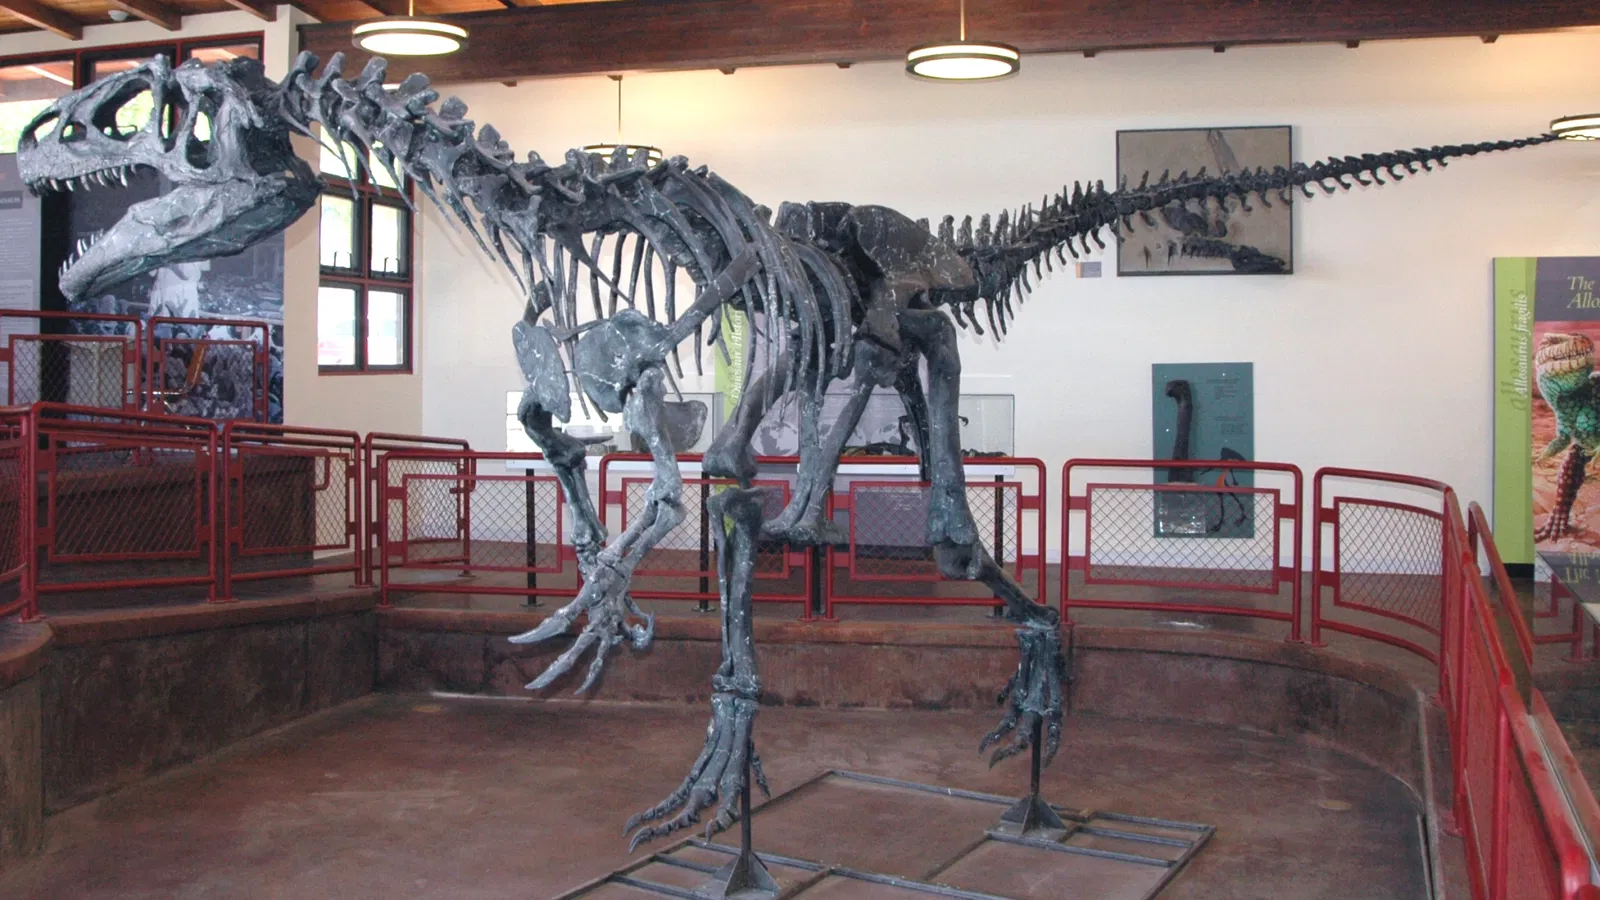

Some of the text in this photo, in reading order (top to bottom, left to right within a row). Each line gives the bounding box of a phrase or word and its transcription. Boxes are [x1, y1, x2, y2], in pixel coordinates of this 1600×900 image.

[1567, 275, 1595, 290] The
[1566, 291, 1600, 309] Allo
[1514, 294, 1531, 398] Allosaurus fragilis
[731, 350, 742, 399] Dinosaur
